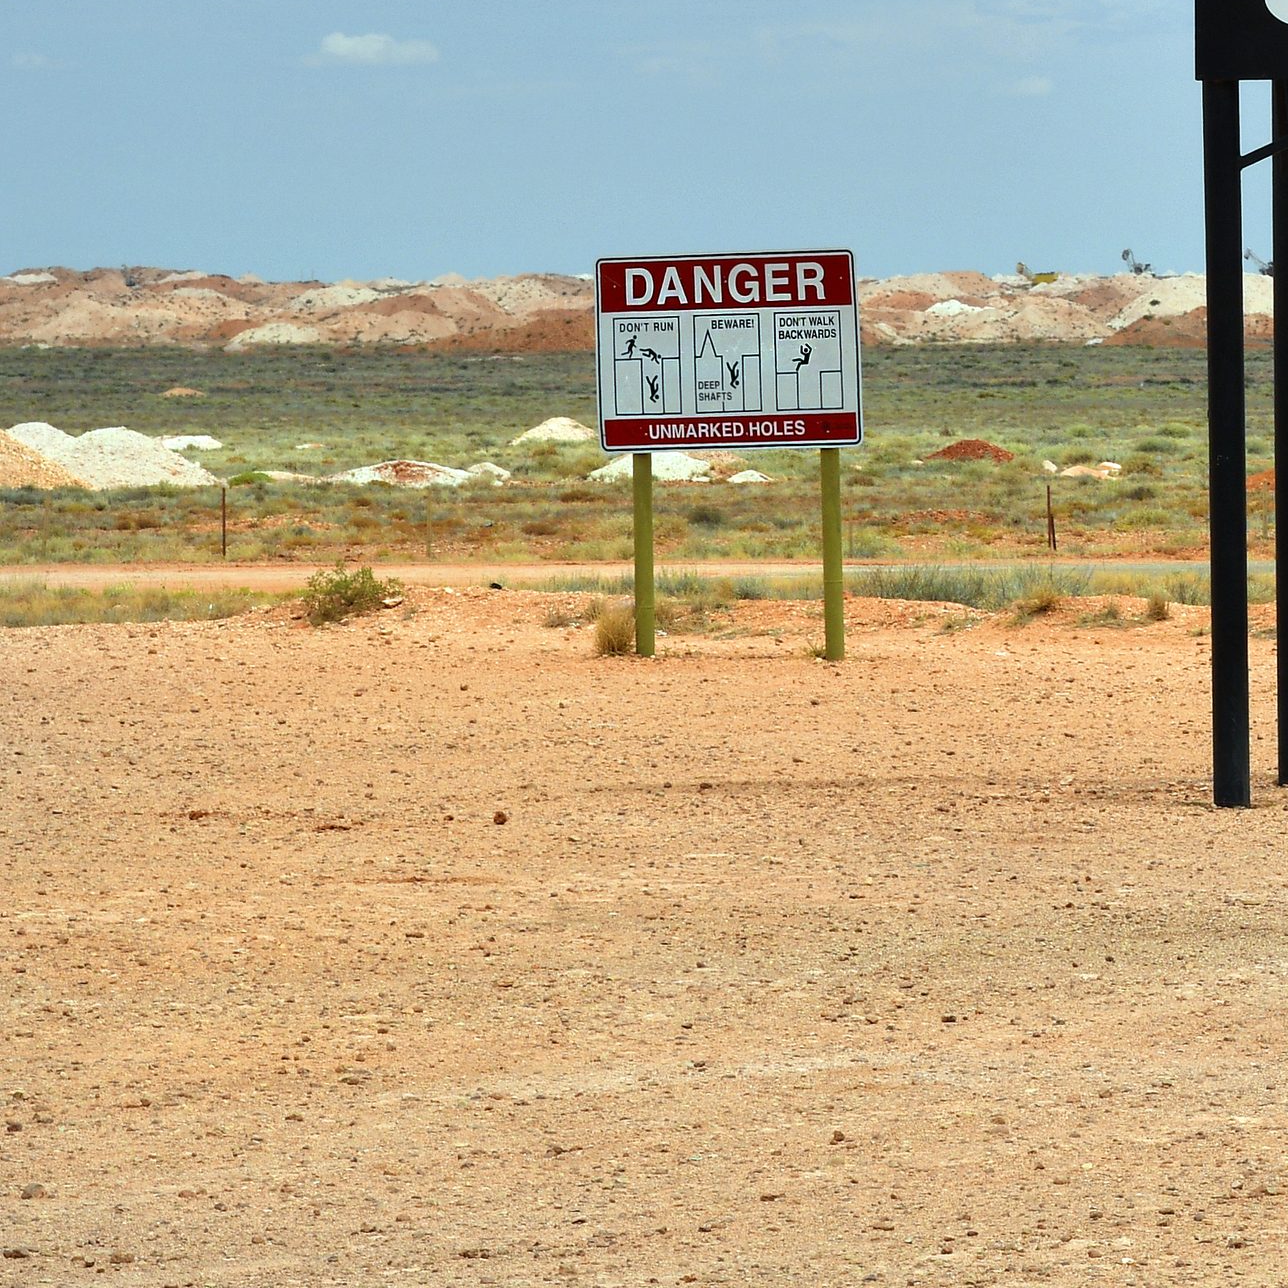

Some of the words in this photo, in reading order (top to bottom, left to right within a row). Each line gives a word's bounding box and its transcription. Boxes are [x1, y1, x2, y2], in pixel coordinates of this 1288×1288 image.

[625, 262, 825, 306] DANGER
[619, 323, 649, 333] DON'T
[654, 322, 674, 332] RUN
[711, 319, 754, 330] BEWARE!
[779, 317, 806, 328] DON'T
[809, 316, 835, 327] WALK
[778, 329, 837, 340] BACKWARDS
[698, 381, 720, 390] DEEP
[698, 392, 732, 402] SHAFTS
[649, 423, 743, 440] UNMARKED
[749, 420, 805, 437] HOLES
